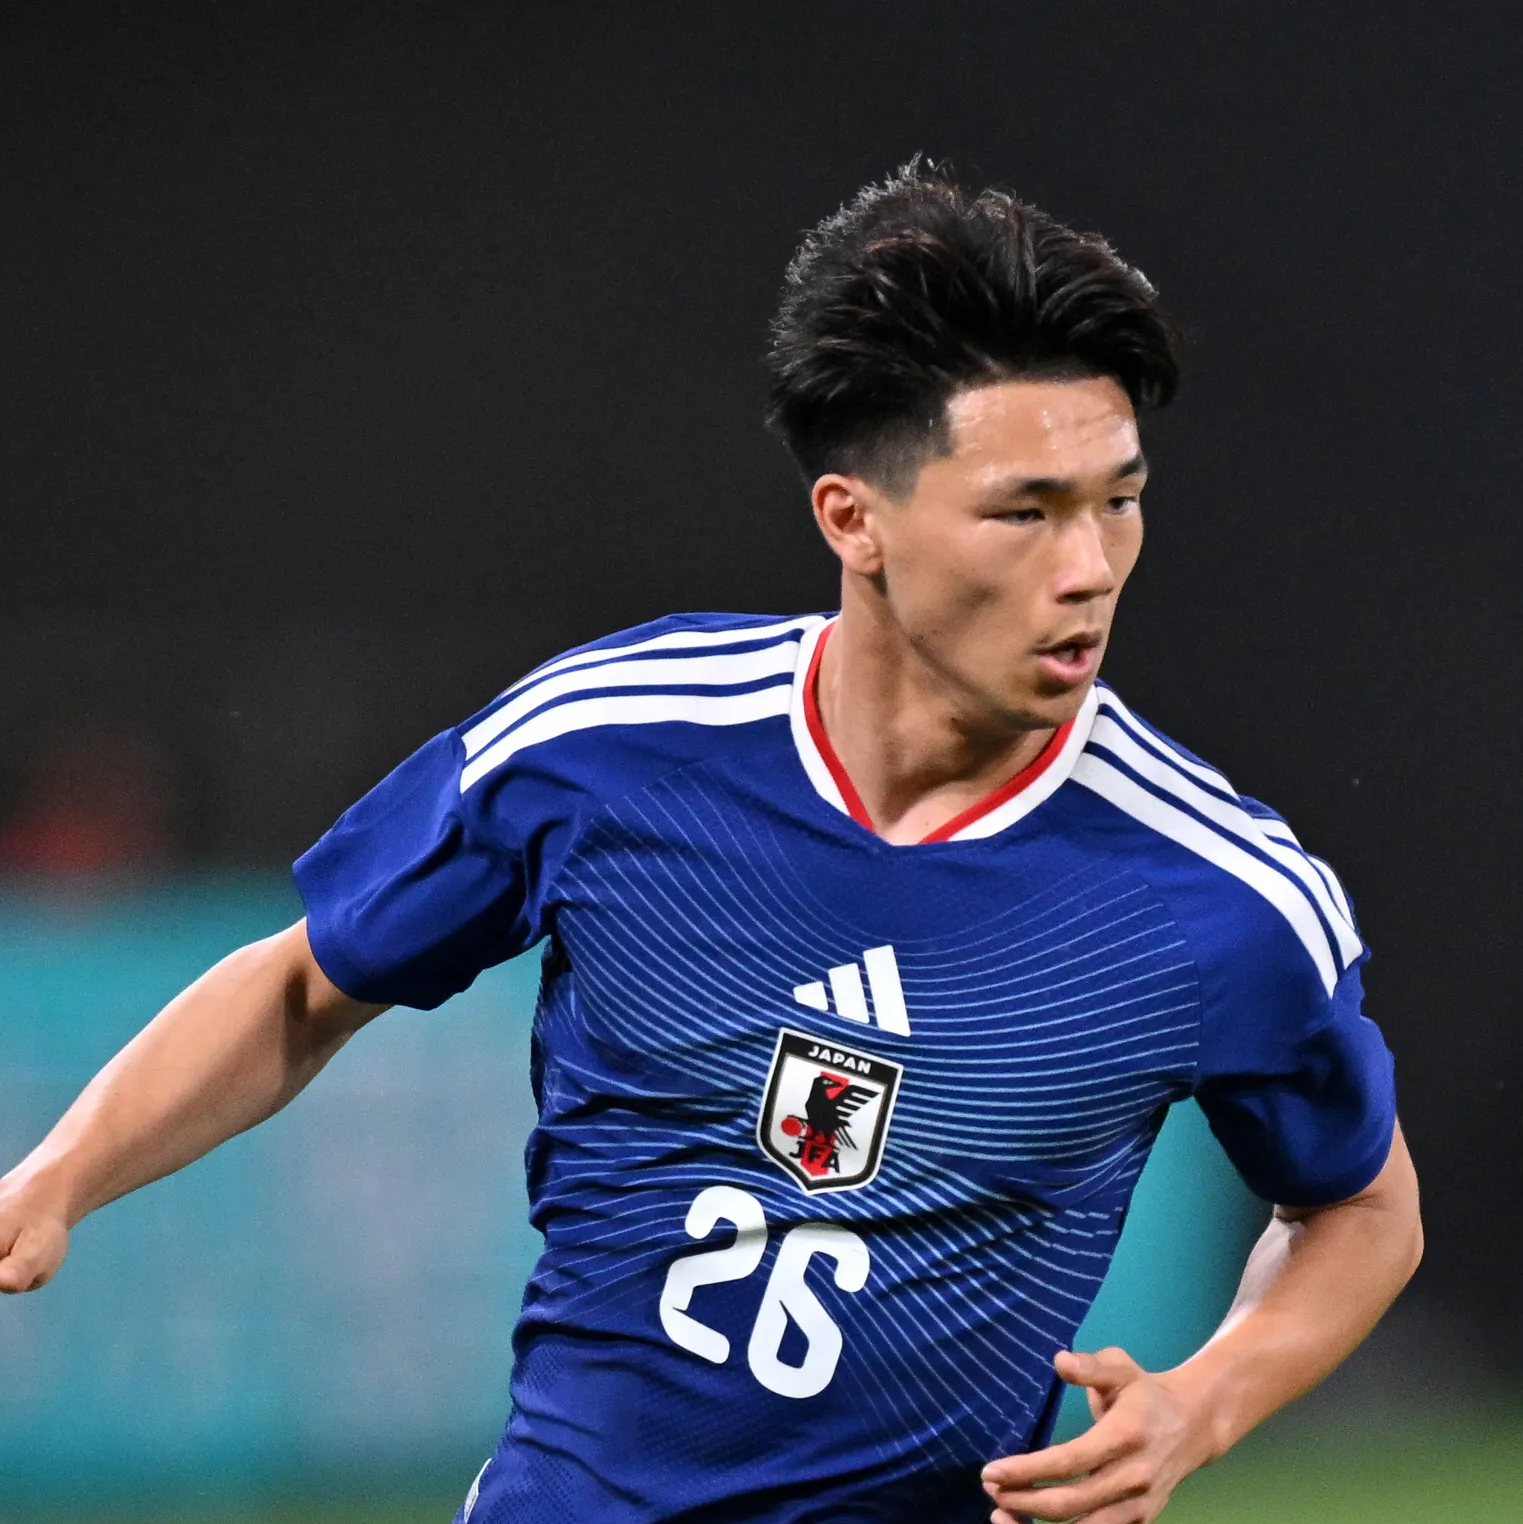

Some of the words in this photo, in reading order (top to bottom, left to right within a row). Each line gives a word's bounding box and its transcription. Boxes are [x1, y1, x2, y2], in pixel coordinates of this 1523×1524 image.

[808, 1045, 872, 1075] JAPAN
[788, 1140, 841, 1174] JFA
[658, 1185, 871, 1399] 26
